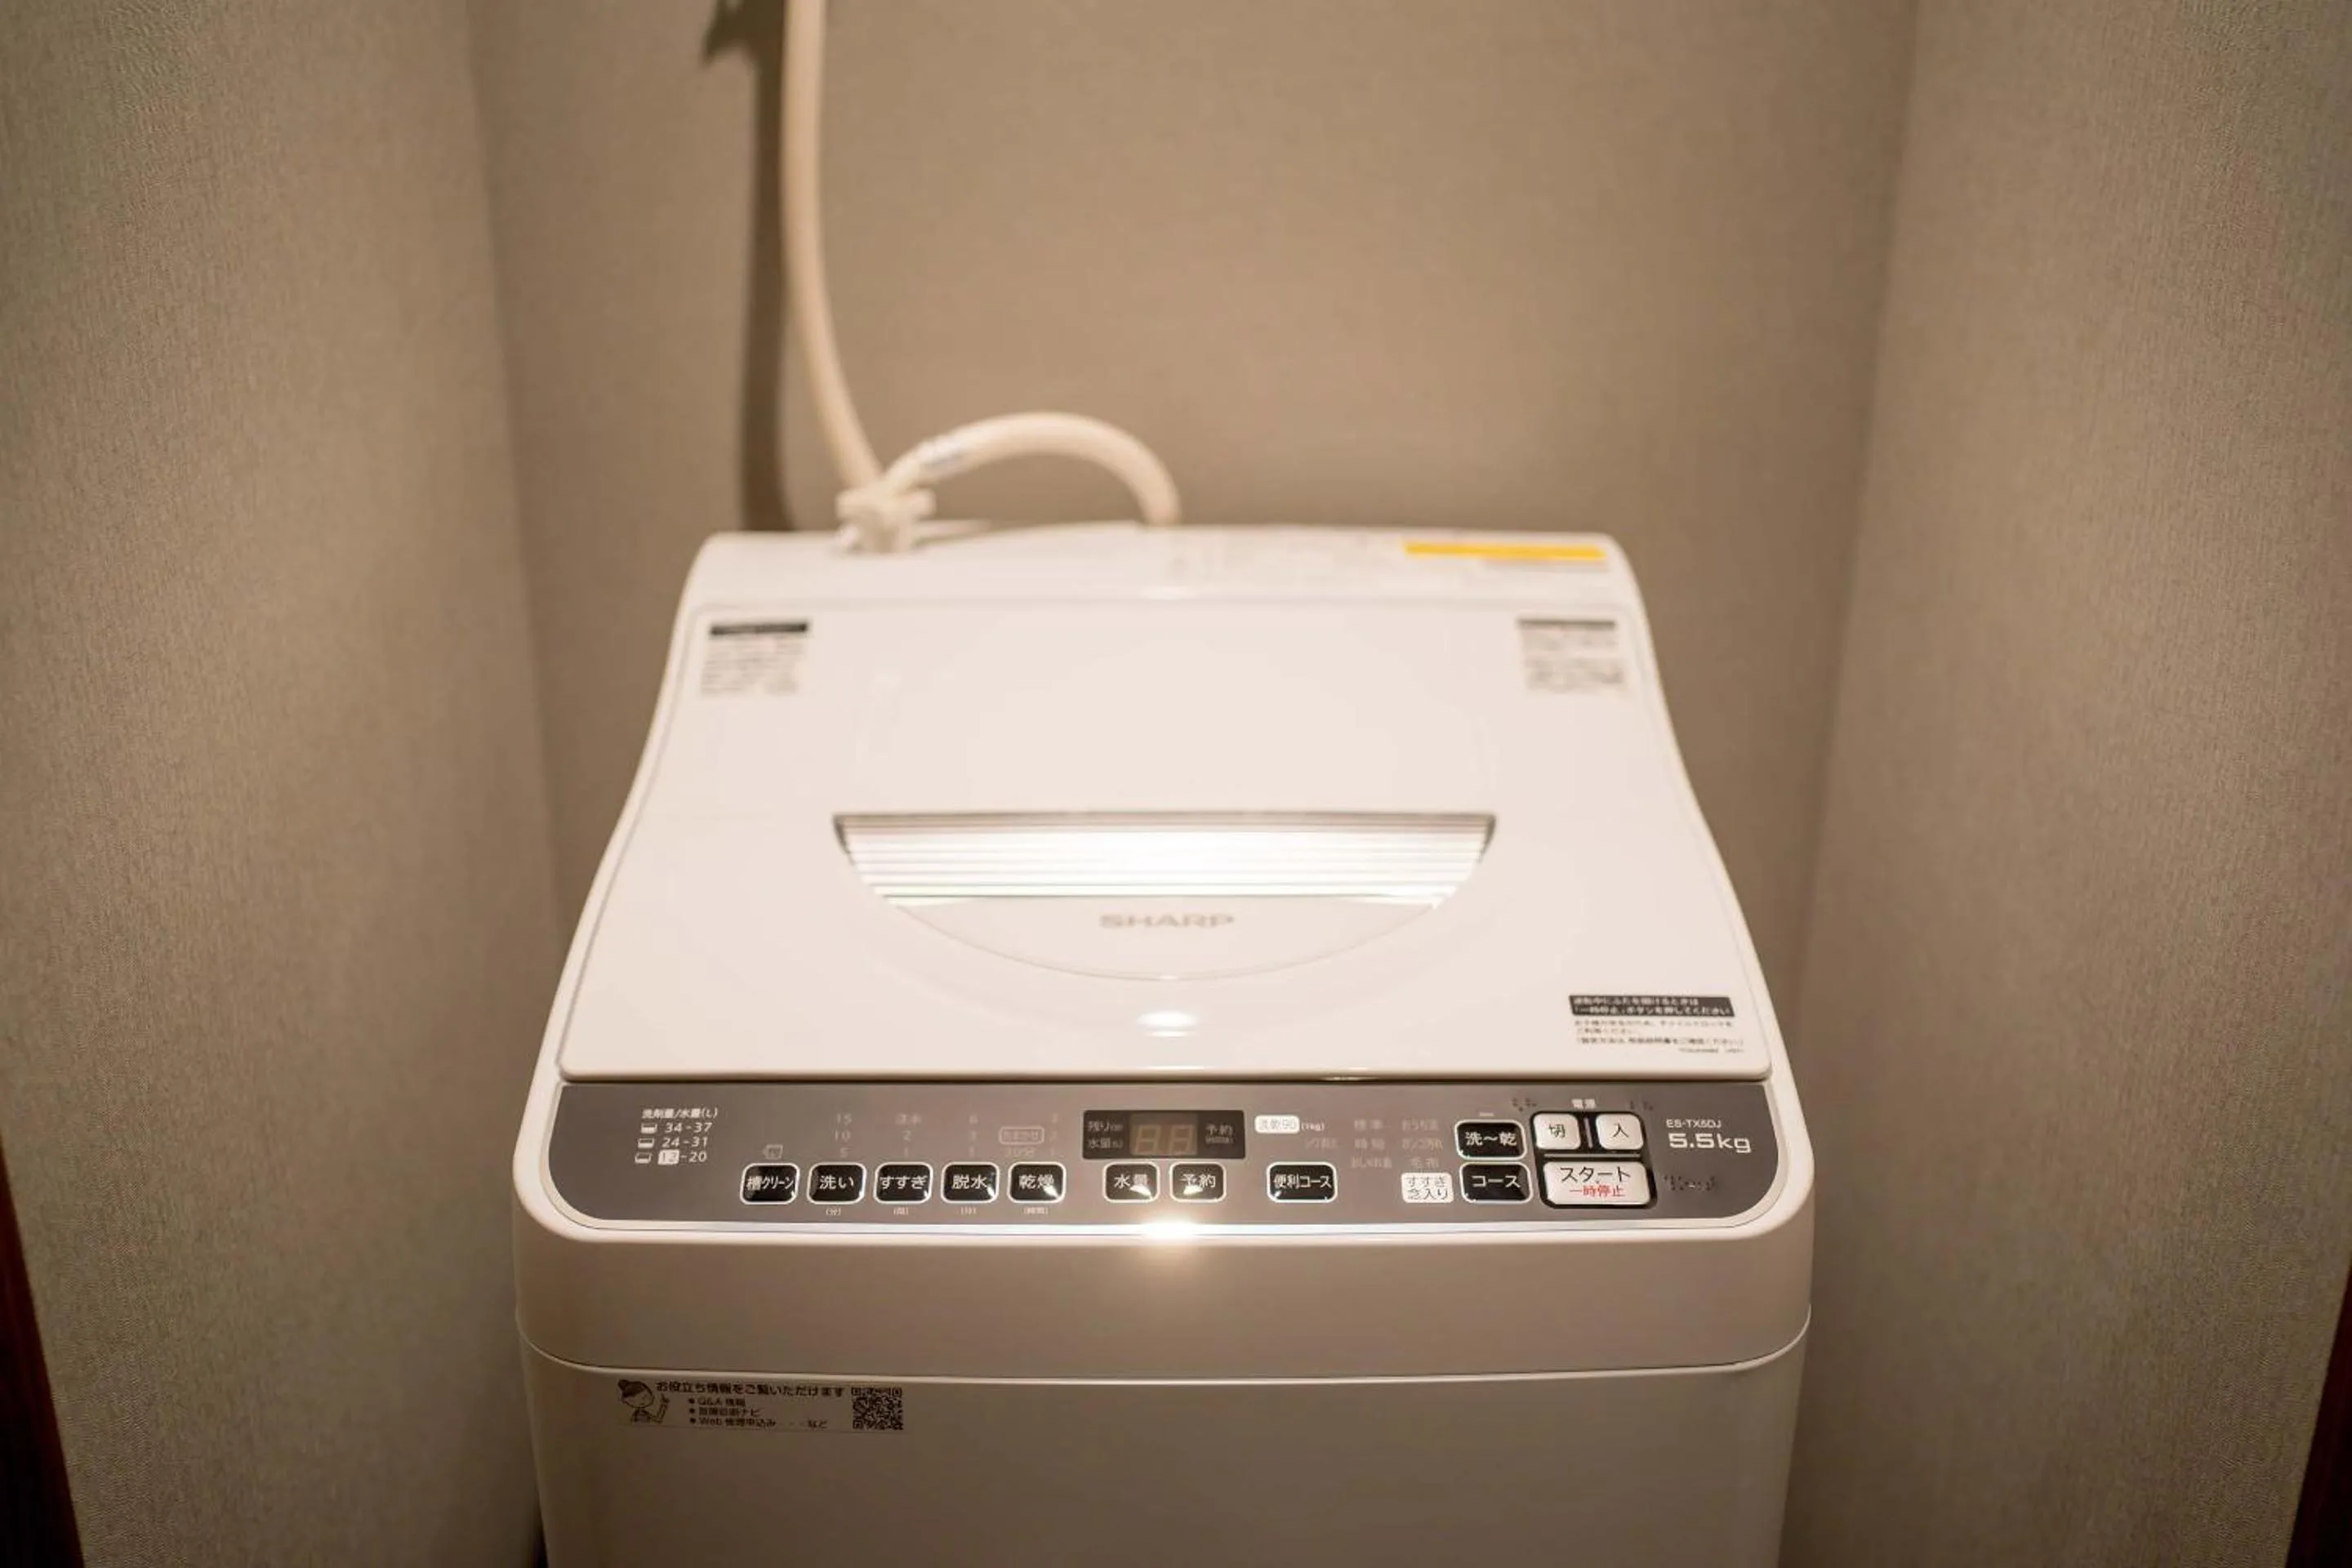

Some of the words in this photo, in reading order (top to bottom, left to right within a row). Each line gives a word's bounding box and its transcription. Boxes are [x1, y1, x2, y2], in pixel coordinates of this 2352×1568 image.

[1099, 914, 1235, 929] SHARP
[665, 1122, 713, 1134] 34-37
[1548, 1123, 1566, 1140] 切
[1611, 1122, 1630, 1139] 入
[662, 1136, 708, 1148] 24-31
[1668, 1133, 1752, 1154] 5.5kg
[819, 1174, 853, 1190] 洗い
[880, 1174, 926, 1190] すすぎ
[951, 1174, 987, 1190] 脱水
[1019, 1174, 1054, 1191] 乾燥
[1178, 1172, 1216, 1189] 予約
[1273, 1174, 1332, 1189] 便利コース
[1472, 1175, 1521, 1188] コース
[1560, 1166, 1631, 1184] スタート
[1569, 1185, 1626, 1198] 一時停止
